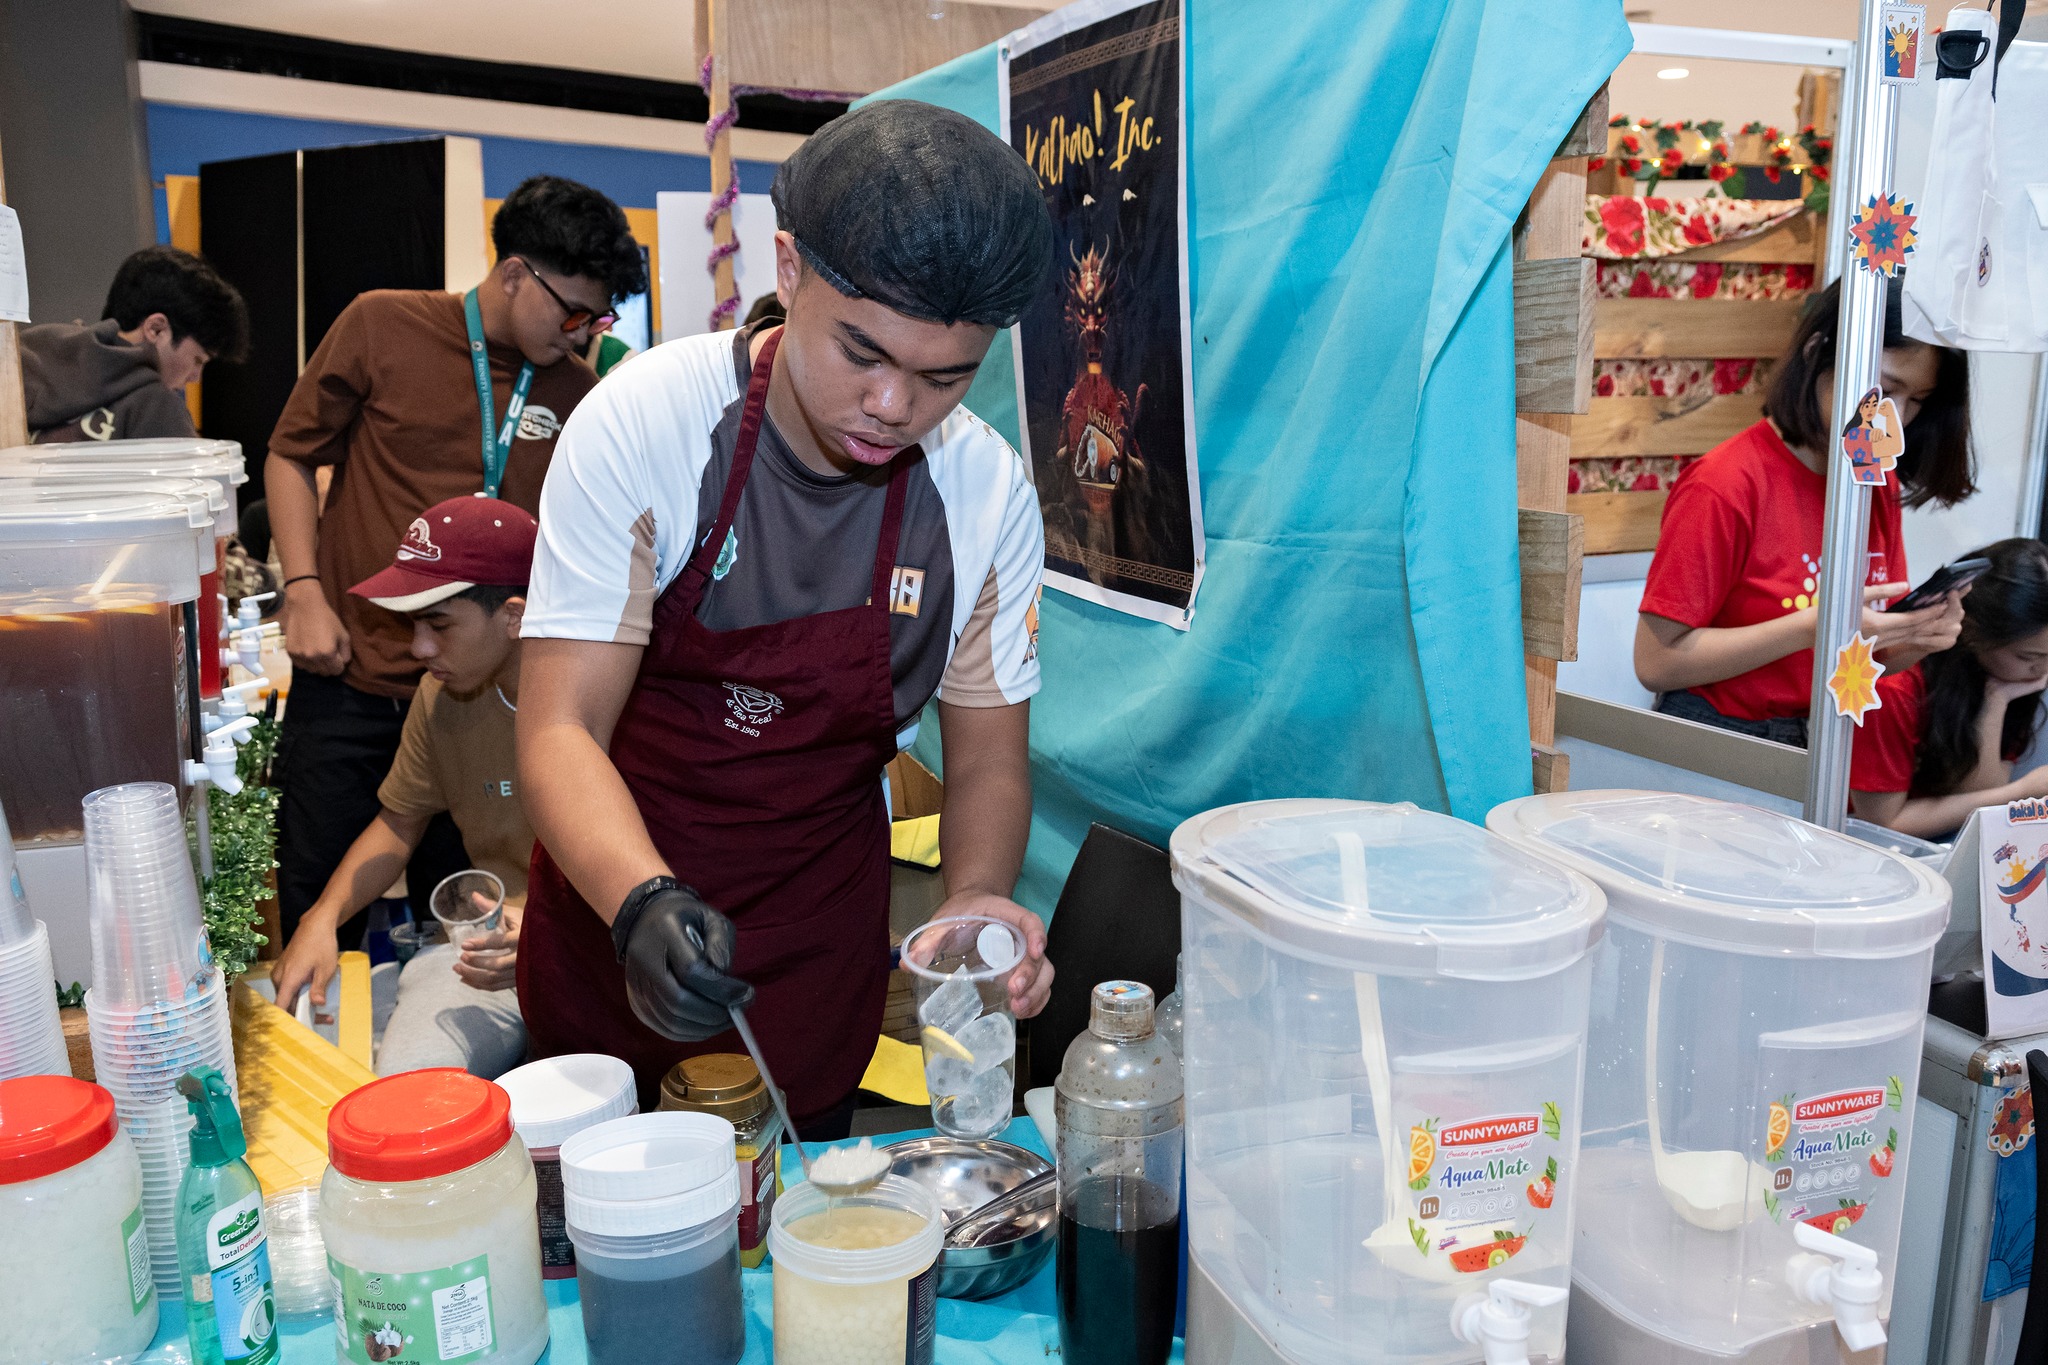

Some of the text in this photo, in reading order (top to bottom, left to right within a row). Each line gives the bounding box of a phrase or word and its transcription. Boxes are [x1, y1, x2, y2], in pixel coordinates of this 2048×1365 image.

[1109, 96, 1162, 172] Inc.
[498, 368, 532, 447] TUA
[733, 706, 747, 721] Tea
[749, 712, 772, 724] Leaf
[740, 726, 760, 738] 1963
[1799, 1094, 1880, 1118] SUNNYWARE
[1444, 1120, 1535, 1144] SUNNYWARE
[1446, 1150, 1469, 1159] Created
[1470, 1149, 1479, 1158] for
[1481, 1149, 1493, 1157] your
[1793, 1130, 1873, 1160] AquaMate
[1440, 1158, 1531, 1188] AquaMate
[220, 1215, 259, 1243] GreenCross
[232, 1264, 259, 1291] 5-in-1
[358, 1298, 407, 1311] NATA DE COCO
